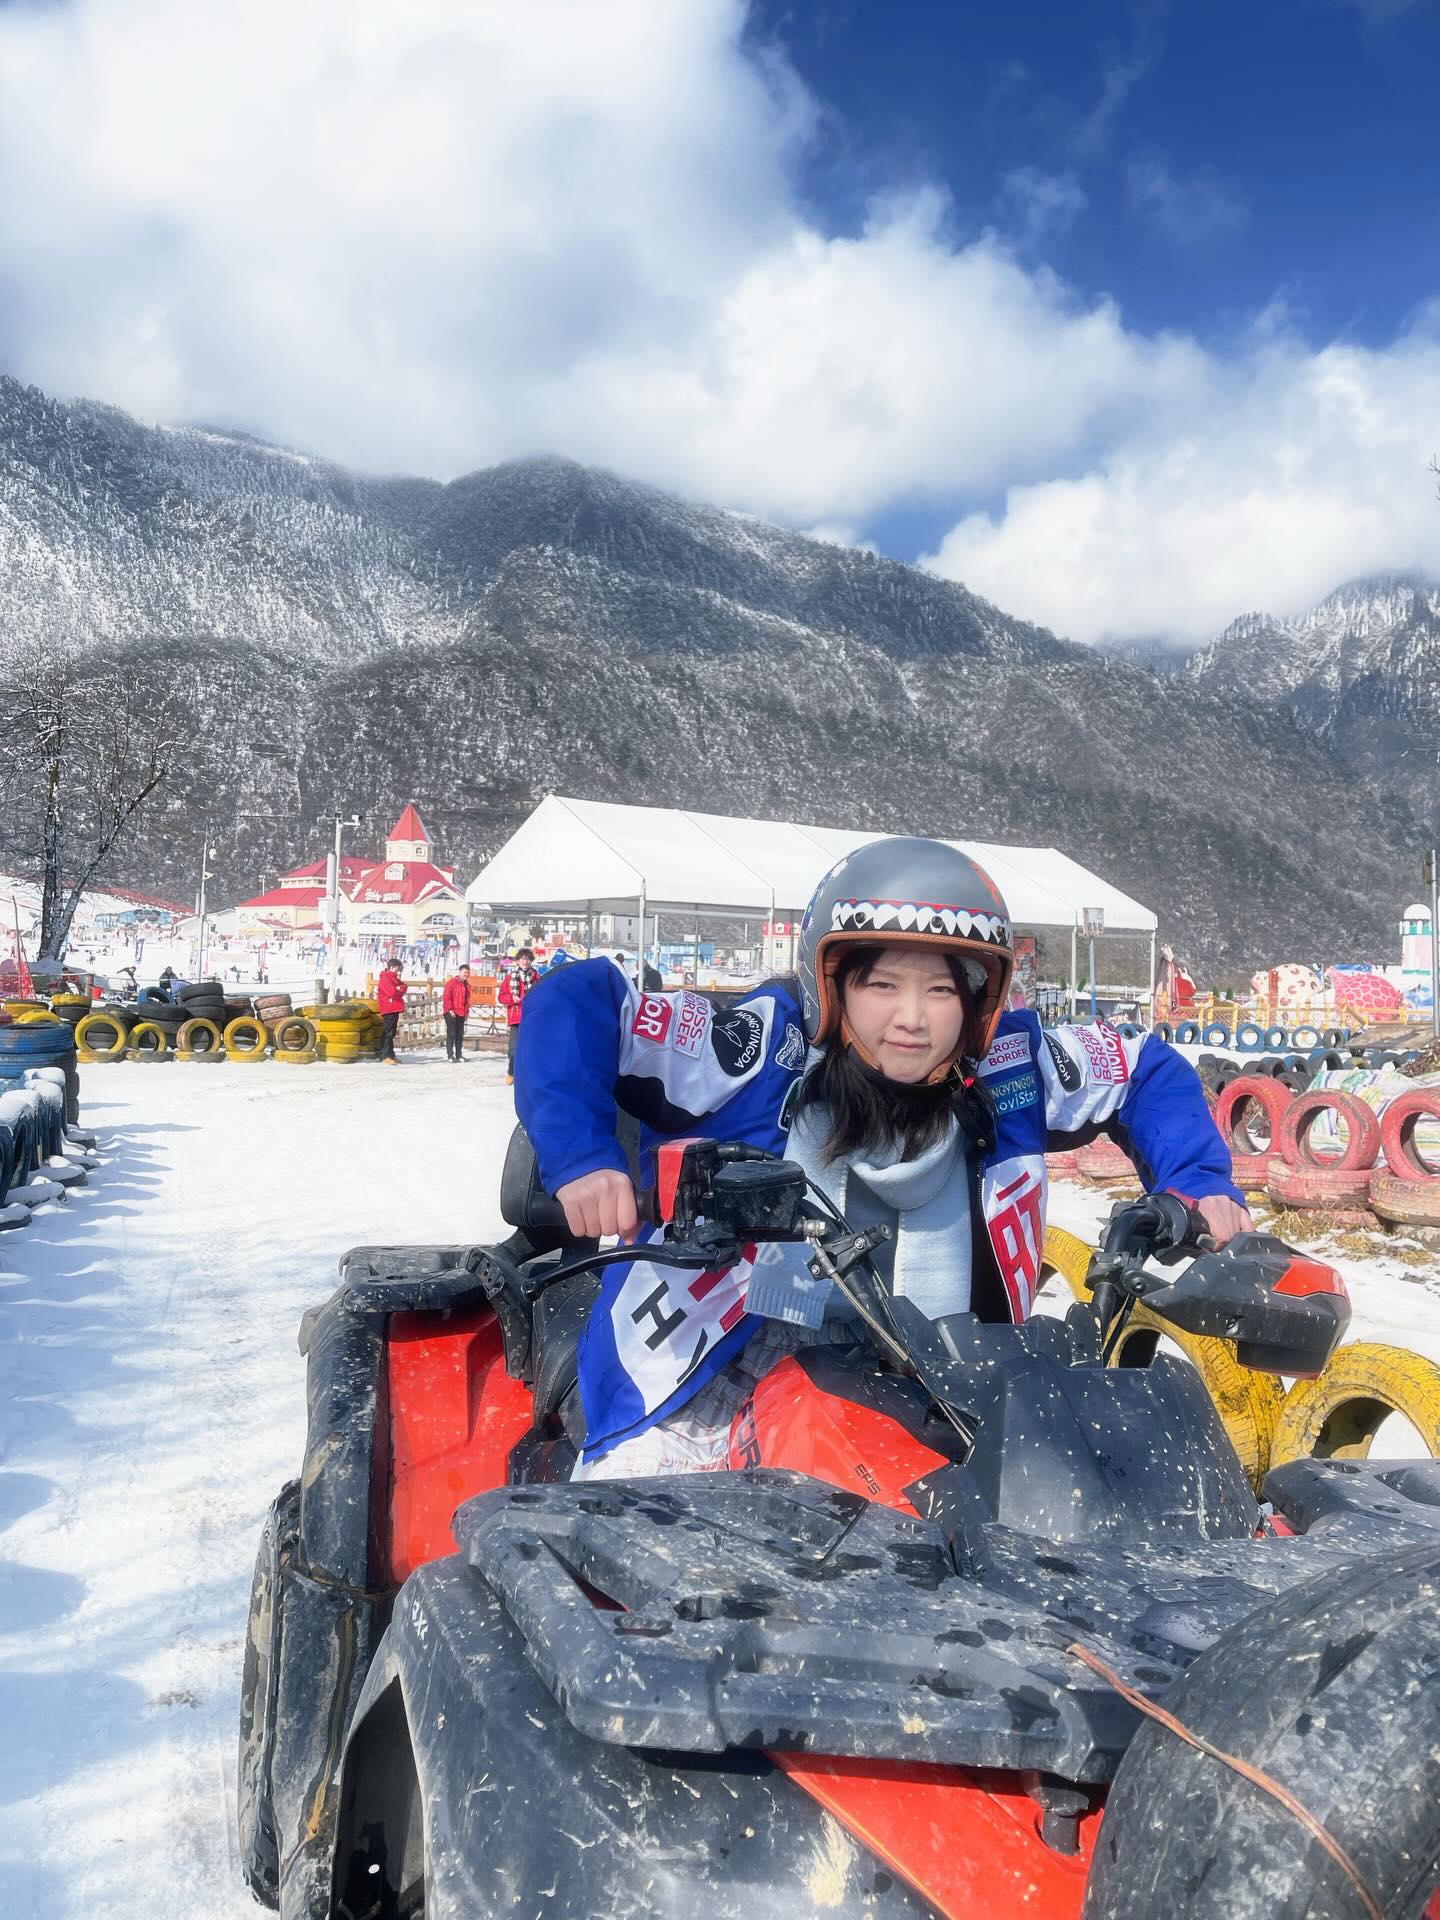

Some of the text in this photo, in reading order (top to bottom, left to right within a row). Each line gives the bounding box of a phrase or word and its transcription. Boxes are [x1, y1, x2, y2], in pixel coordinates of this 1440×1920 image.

[637, 998, 666, 1036] OR
[734, 1011, 761, 1069] HONGYINGDA
[989, 1048, 1029, 1067] BORDER
[855, 1463, 881, 1495] EPS
